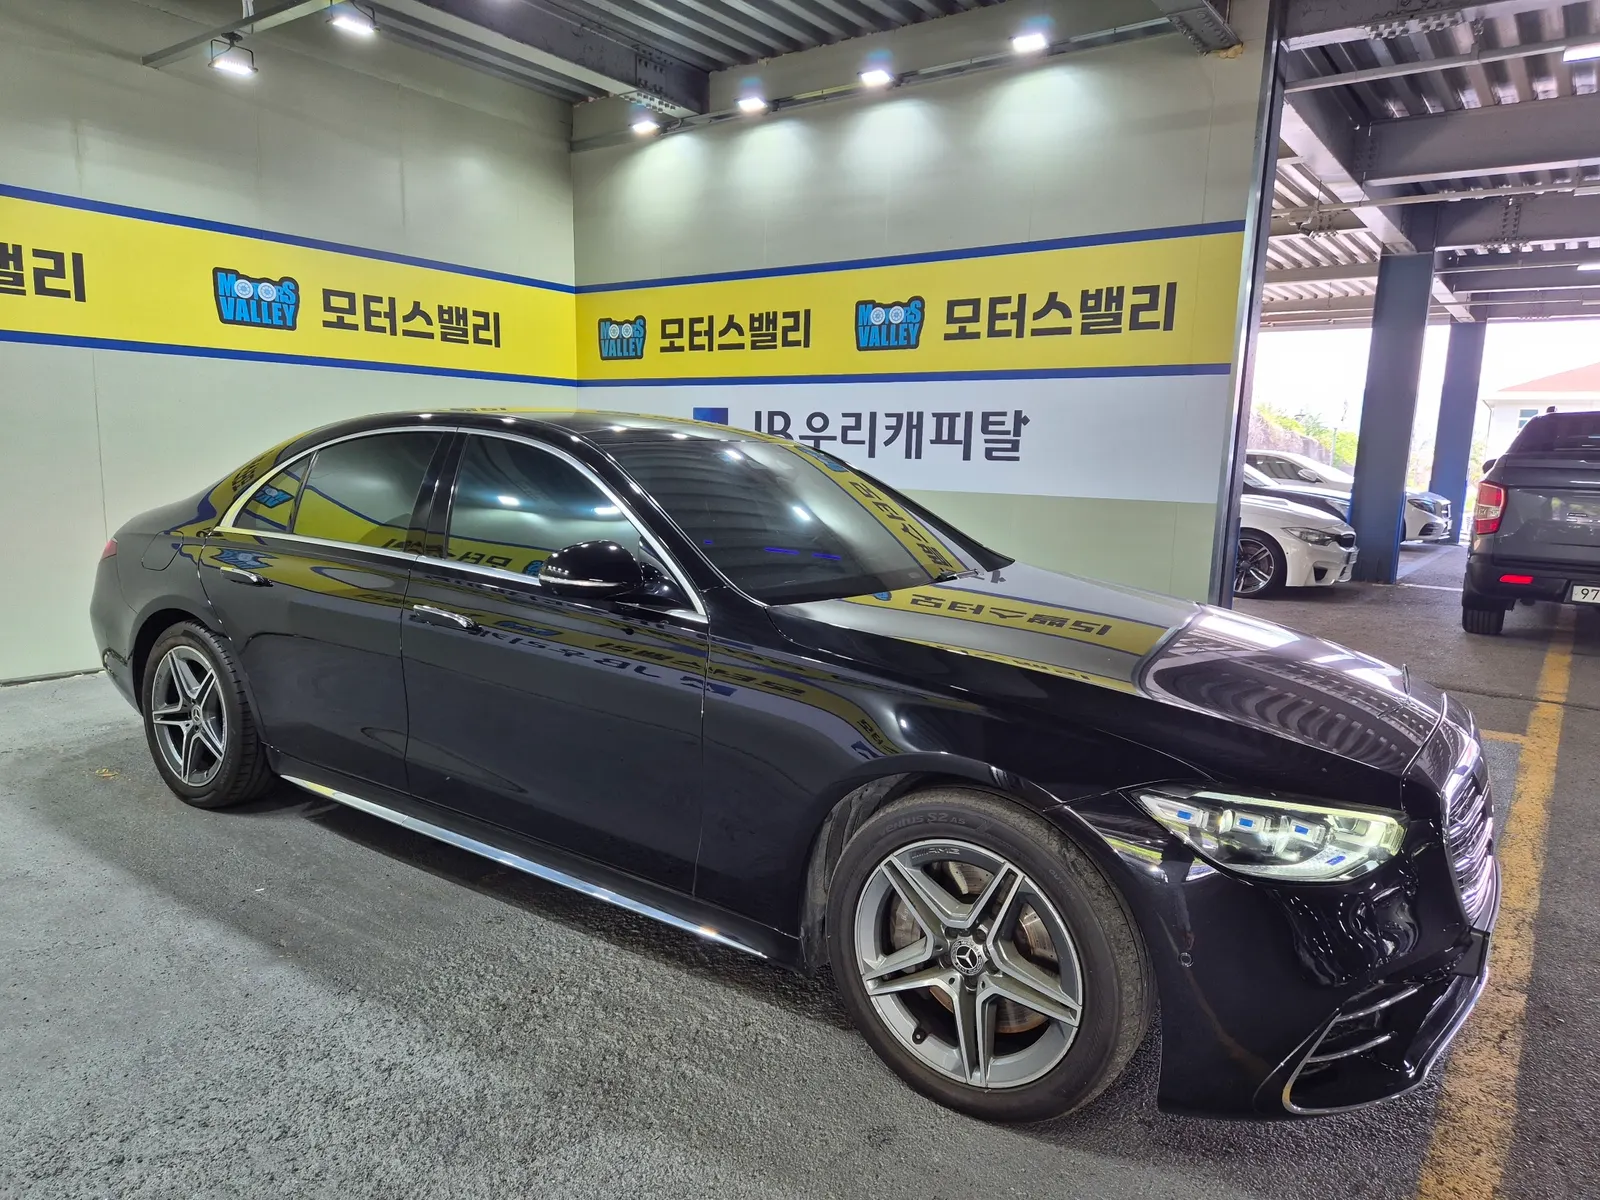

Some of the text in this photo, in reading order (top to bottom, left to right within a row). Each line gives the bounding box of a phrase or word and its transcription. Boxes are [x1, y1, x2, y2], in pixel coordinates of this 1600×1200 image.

[219, 296, 296, 327] VALLEY
[322, 288, 500, 348] 모터스밸리
[943, 281, 1178, 341] 모터스밸리
[659, 308, 811, 352] 모터스밸리
[858, 323, 919, 347] VALLEY
[600, 337, 643, 357] VALLEY
[1581, 587, 1600, 601] 97
